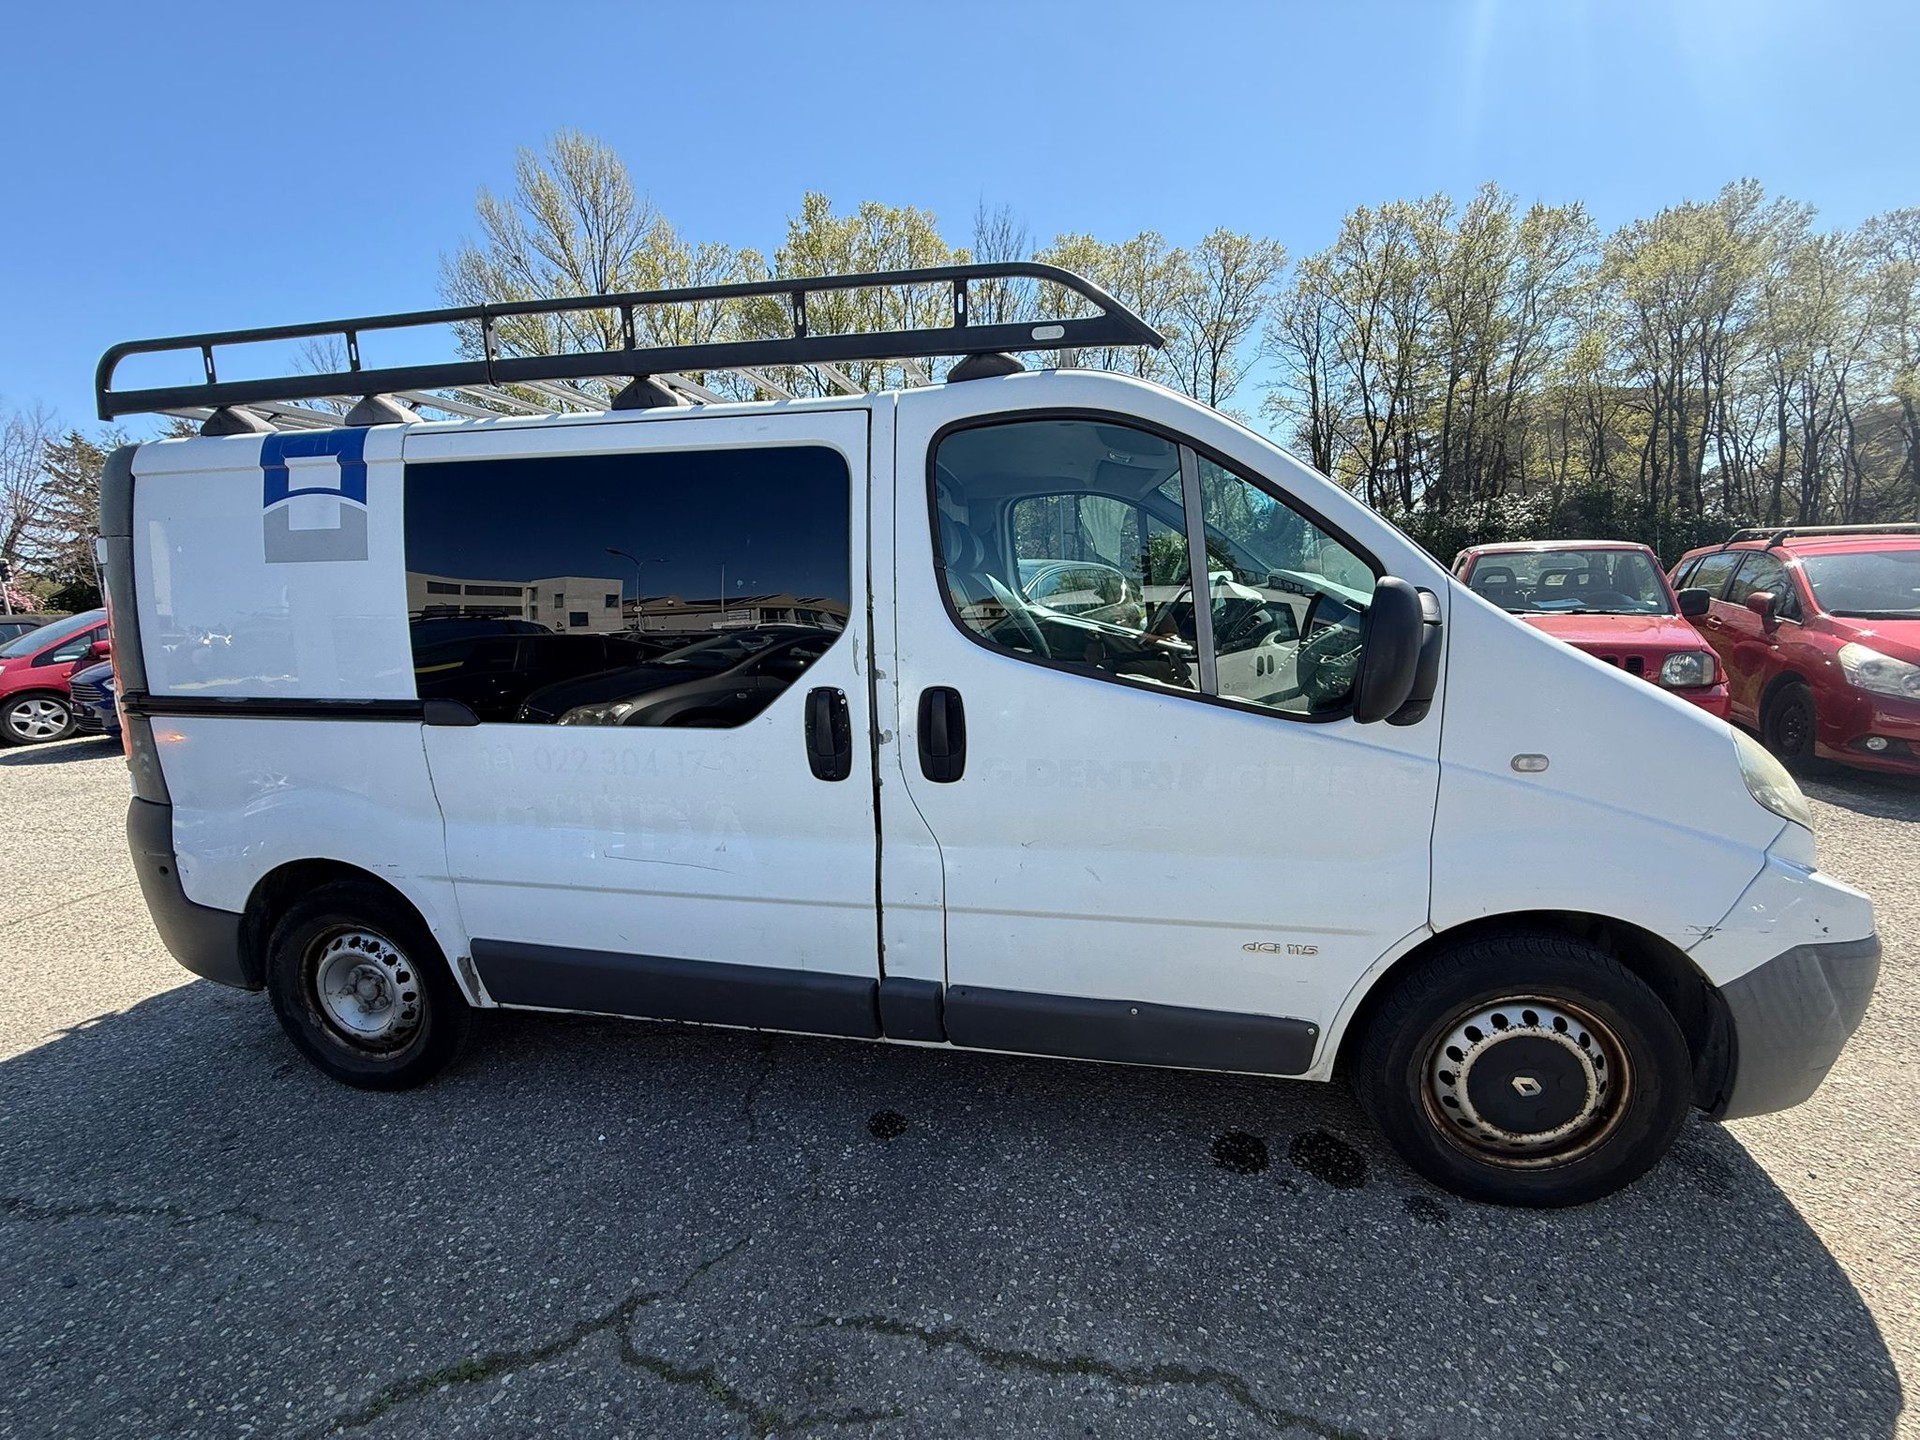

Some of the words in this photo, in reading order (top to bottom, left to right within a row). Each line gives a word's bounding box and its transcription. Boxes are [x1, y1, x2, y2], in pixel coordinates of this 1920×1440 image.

[533, 745, 591, 774] 022
[601, 746, 660, 777] 304
[1286, 943, 1319, 956] 115
